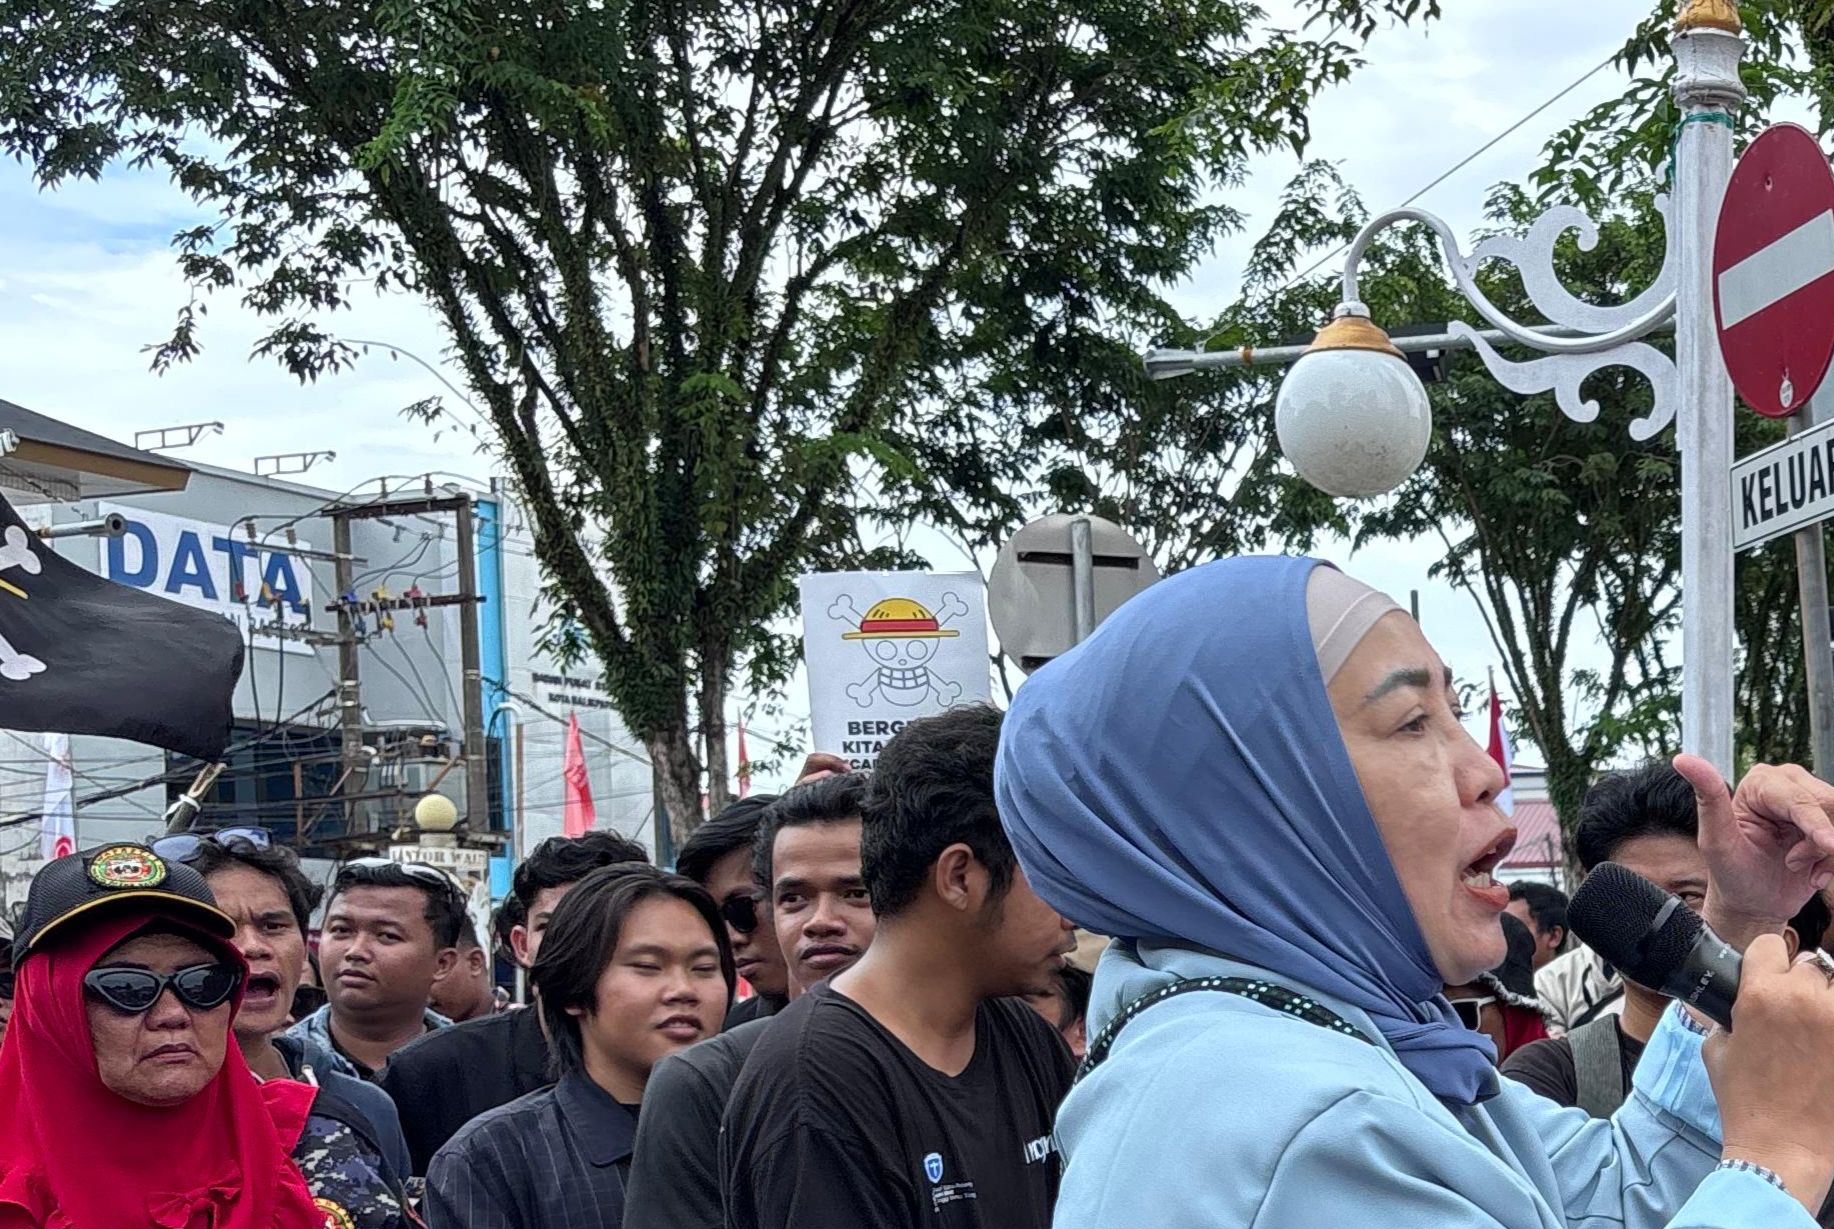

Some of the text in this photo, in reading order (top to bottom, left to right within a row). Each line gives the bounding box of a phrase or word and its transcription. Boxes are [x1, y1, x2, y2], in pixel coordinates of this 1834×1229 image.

[108, 520, 311, 615] DATA
[848, 720, 915, 736] BERG
[842, 741, 883, 754] KITA
